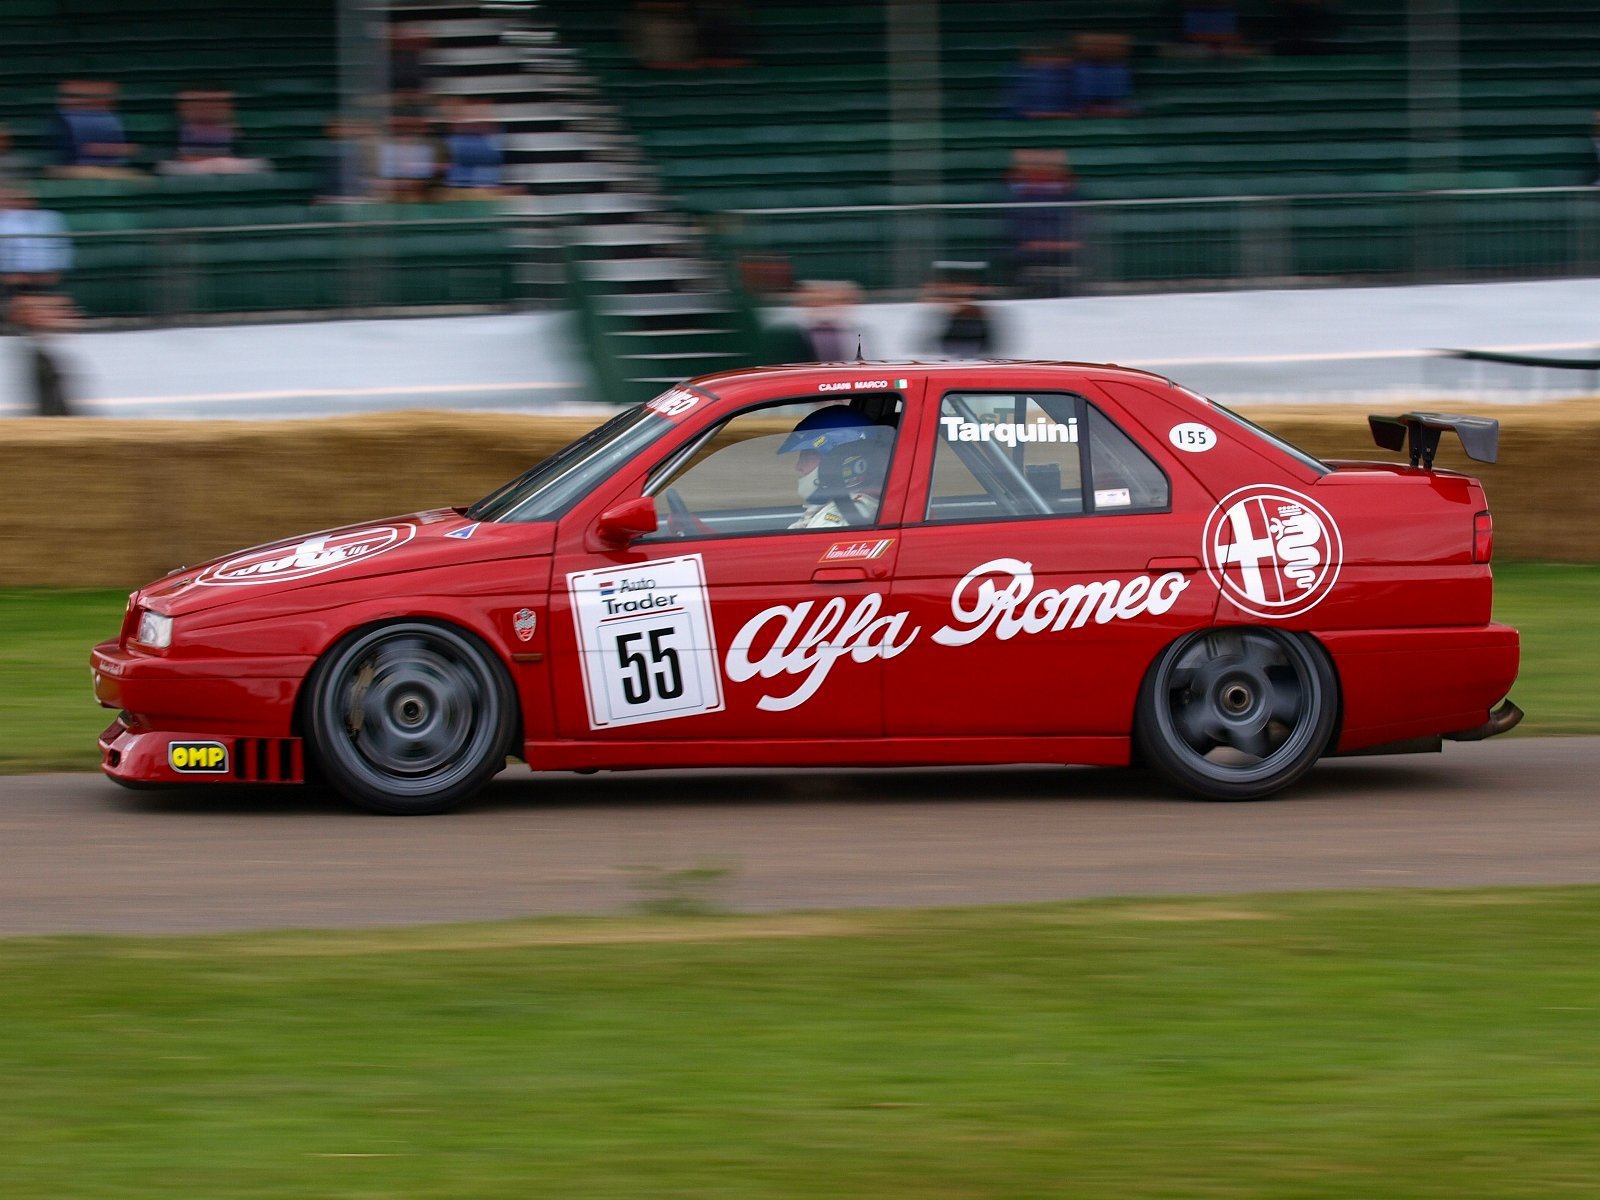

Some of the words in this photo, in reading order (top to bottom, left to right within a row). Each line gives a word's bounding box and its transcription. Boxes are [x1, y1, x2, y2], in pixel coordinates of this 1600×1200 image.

[854, 380, 888, 389] MARCO
[940, 416, 1079, 448] Tarquini
[1178, 430, 1207, 445] 155
[619, 577, 657, 594] Auto
[602, 593, 678, 615] Trader
[931, 557, 1190, 647] Romeo
[615, 626, 684, 705] 55
[172, 746, 225, 768] OMP
